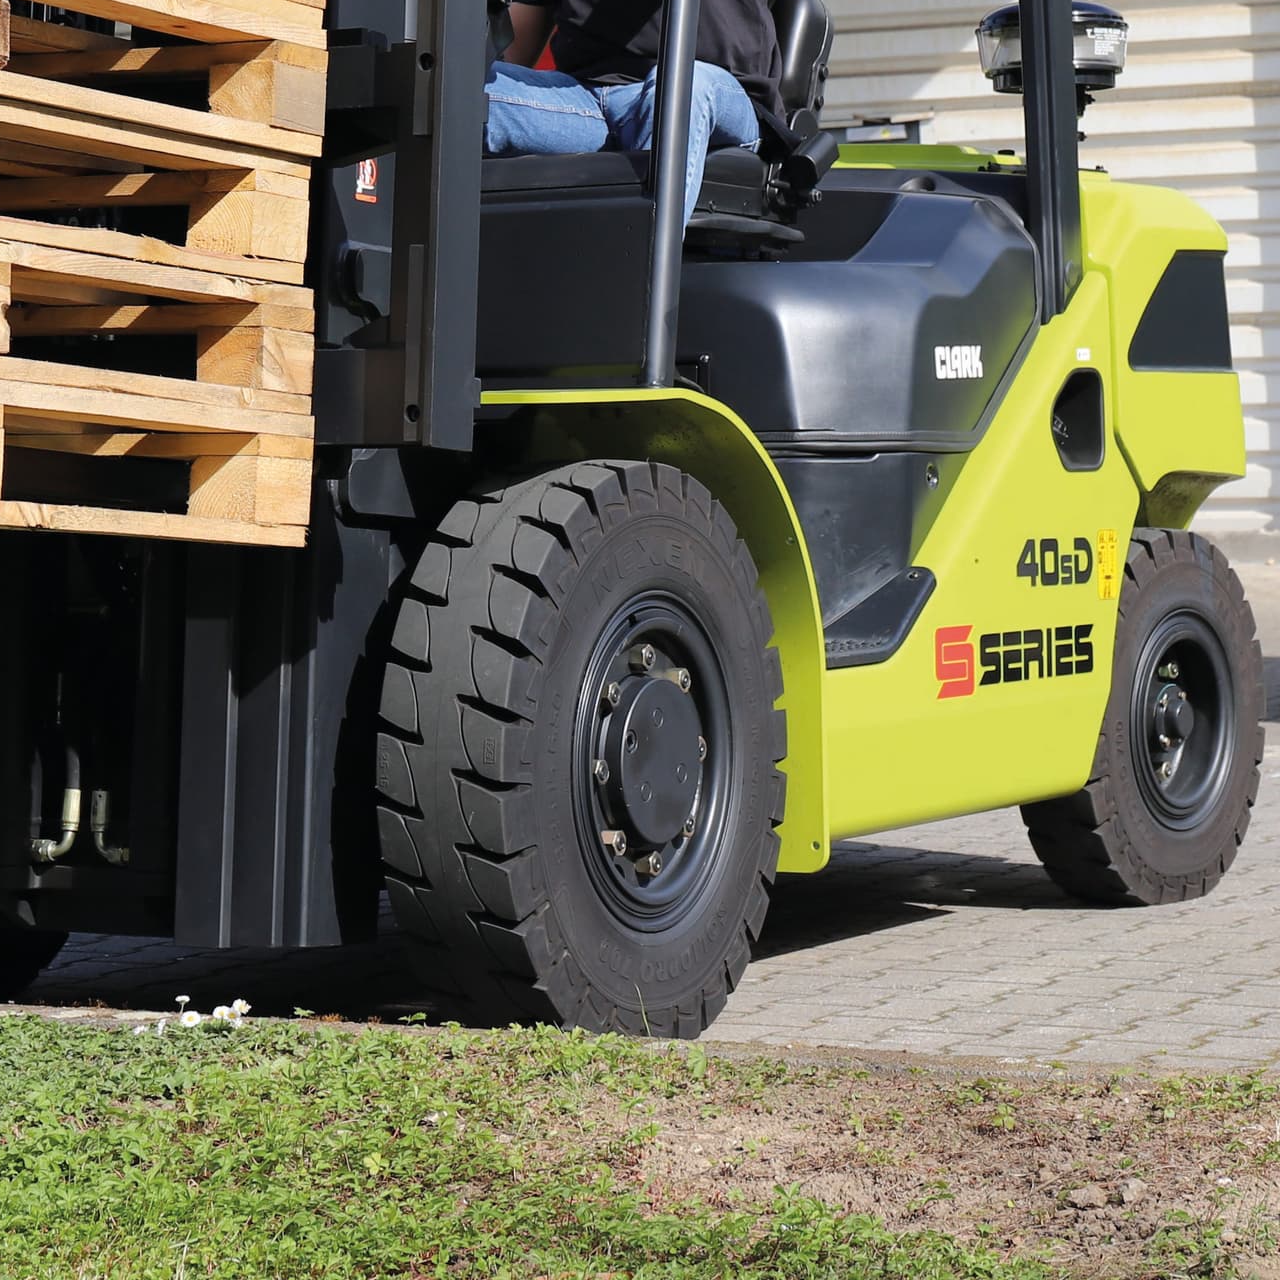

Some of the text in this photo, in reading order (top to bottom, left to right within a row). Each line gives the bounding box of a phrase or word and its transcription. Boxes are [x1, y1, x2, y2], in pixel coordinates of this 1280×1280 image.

[934, 345, 984, 380] CLARK
[591, 535, 704, 607] NEXEN
[979, 624, 1094, 686] SERIES
